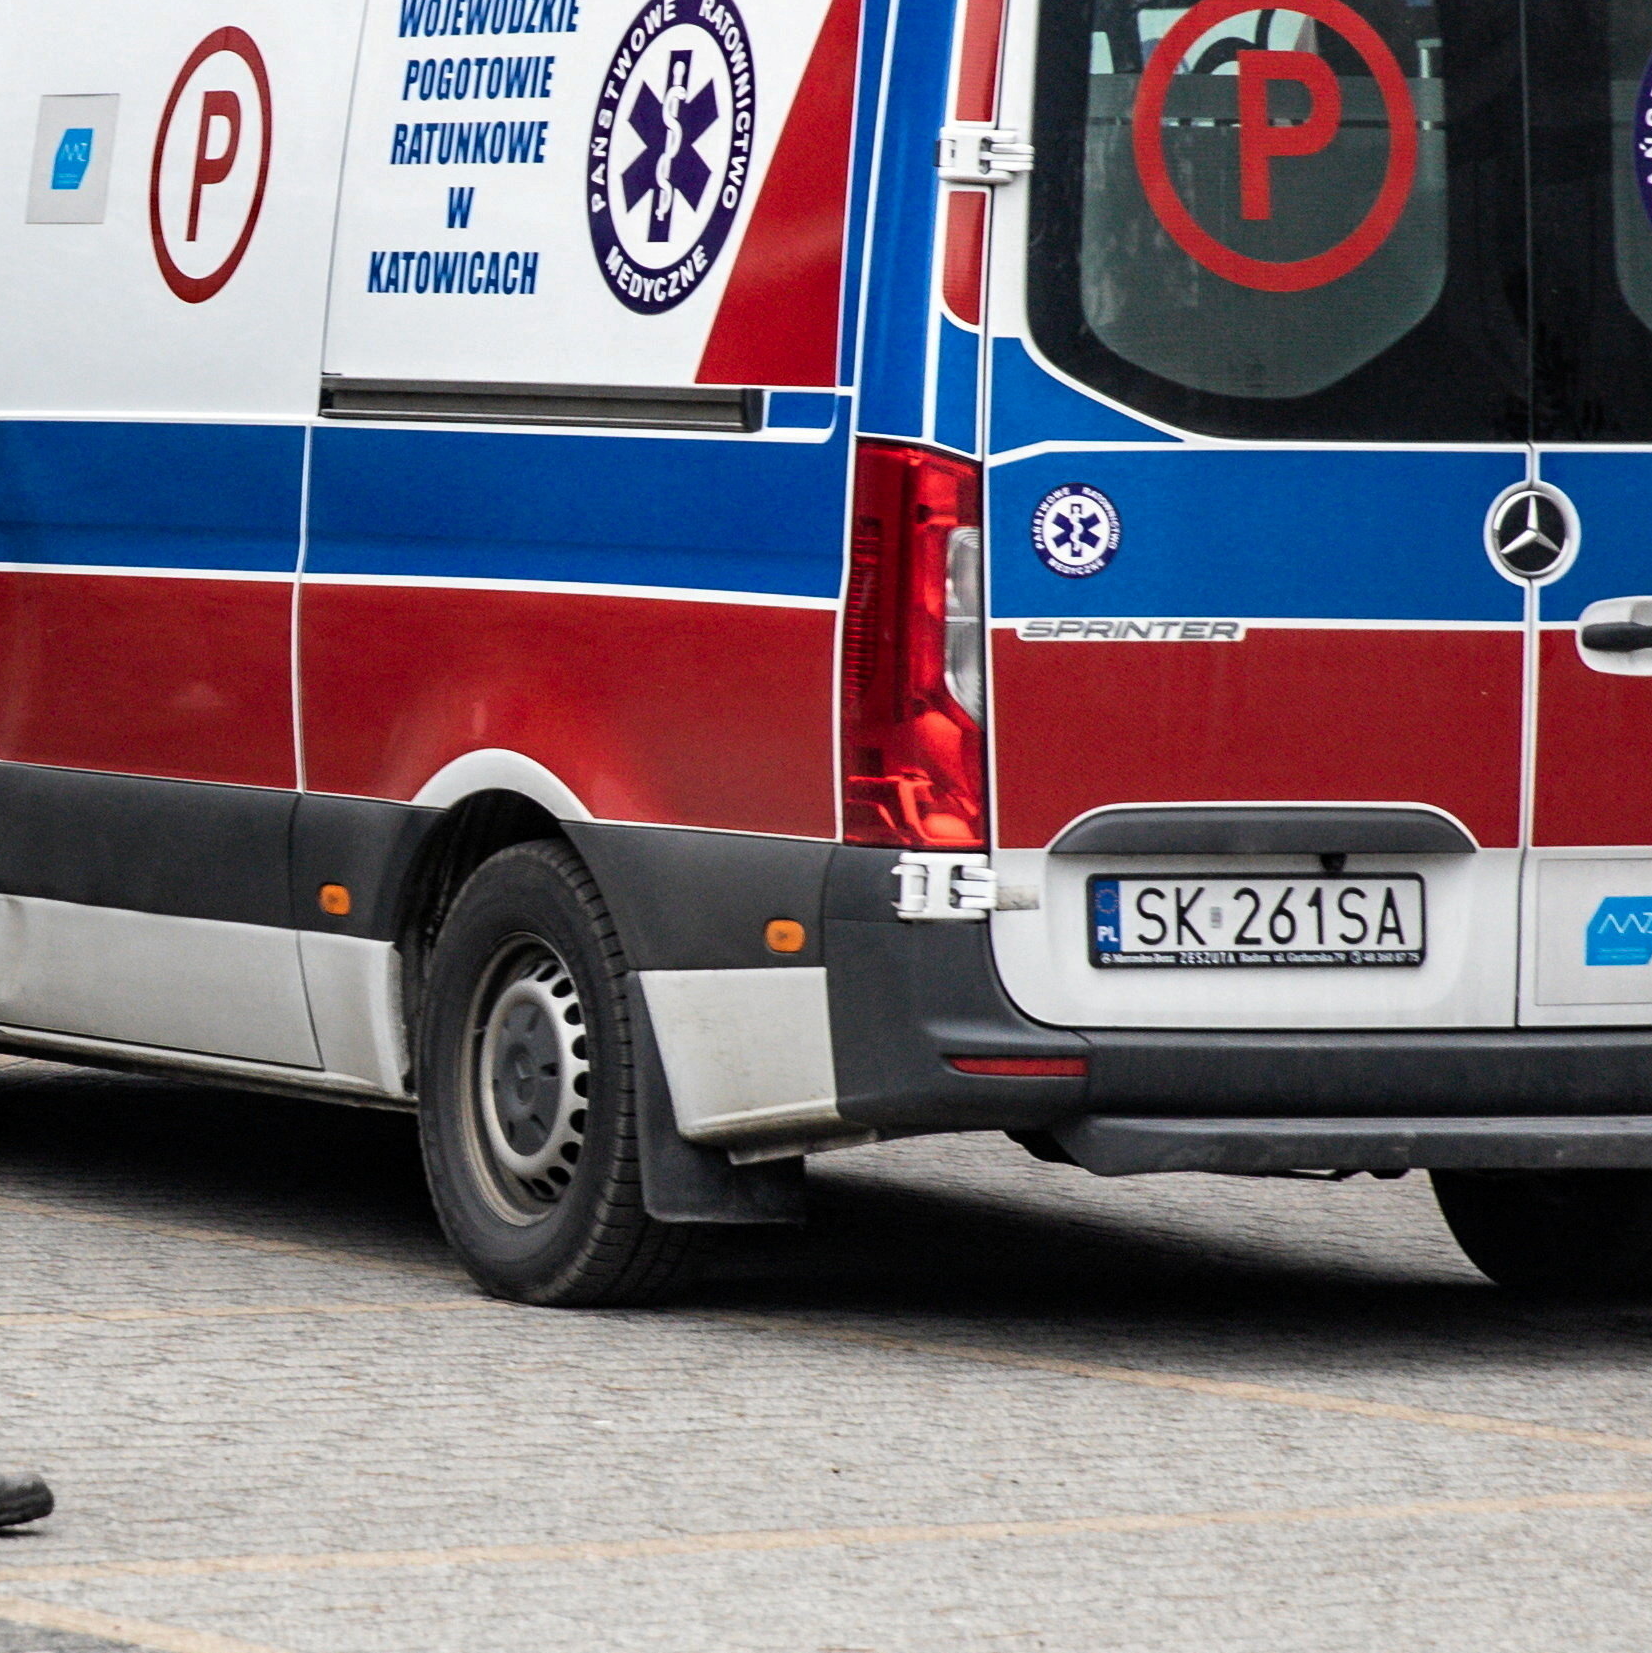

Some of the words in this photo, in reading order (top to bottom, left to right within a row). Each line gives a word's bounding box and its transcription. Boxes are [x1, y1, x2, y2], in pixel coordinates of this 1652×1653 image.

[402, 55, 555, 100] POGOTOWIE
[390, 121, 549, 164] RATUNKOWE
[1237, 50, 1341, 220] P
[186, 89, 241, 242] P
[446, 186, 475, 228] W
[367, 250, 539, 294] KATOWICACH
[604, 244, 708, 302] MEDYCZNE
[1021, 620, 1240, 639] SPRINTER
[1098, 925, 1119, 943] PL
[1136, 886, 1207, 946] SK
[1233, 885, 1406, 946] 261SA
